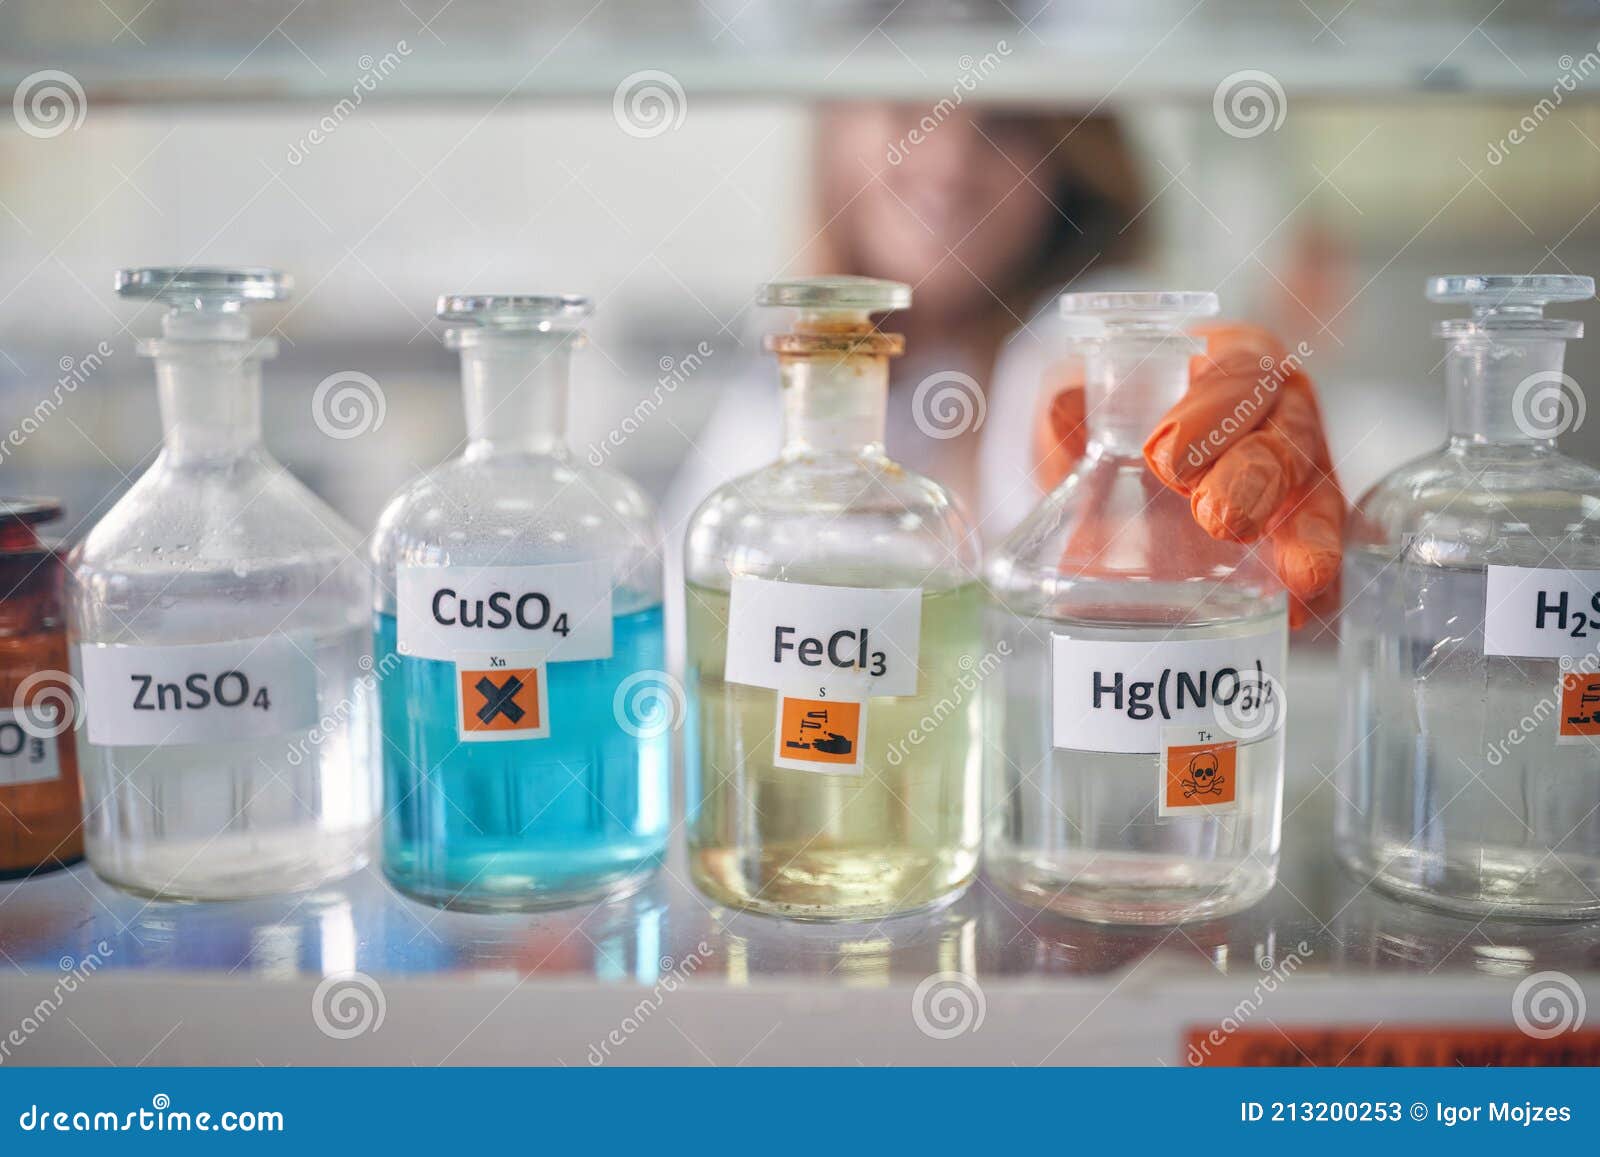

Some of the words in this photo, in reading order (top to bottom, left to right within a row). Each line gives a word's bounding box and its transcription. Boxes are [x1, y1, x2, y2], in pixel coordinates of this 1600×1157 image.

[432, 588, 570, 637] CuSO4
[490, 656, 506, 667] Xn
[773, 625, 887, 677] FeCl3
[131, 670, 271, 711] ZnSO4
[819, 687, 826, 697] S
[1198, 731, 1213, 742] T+
